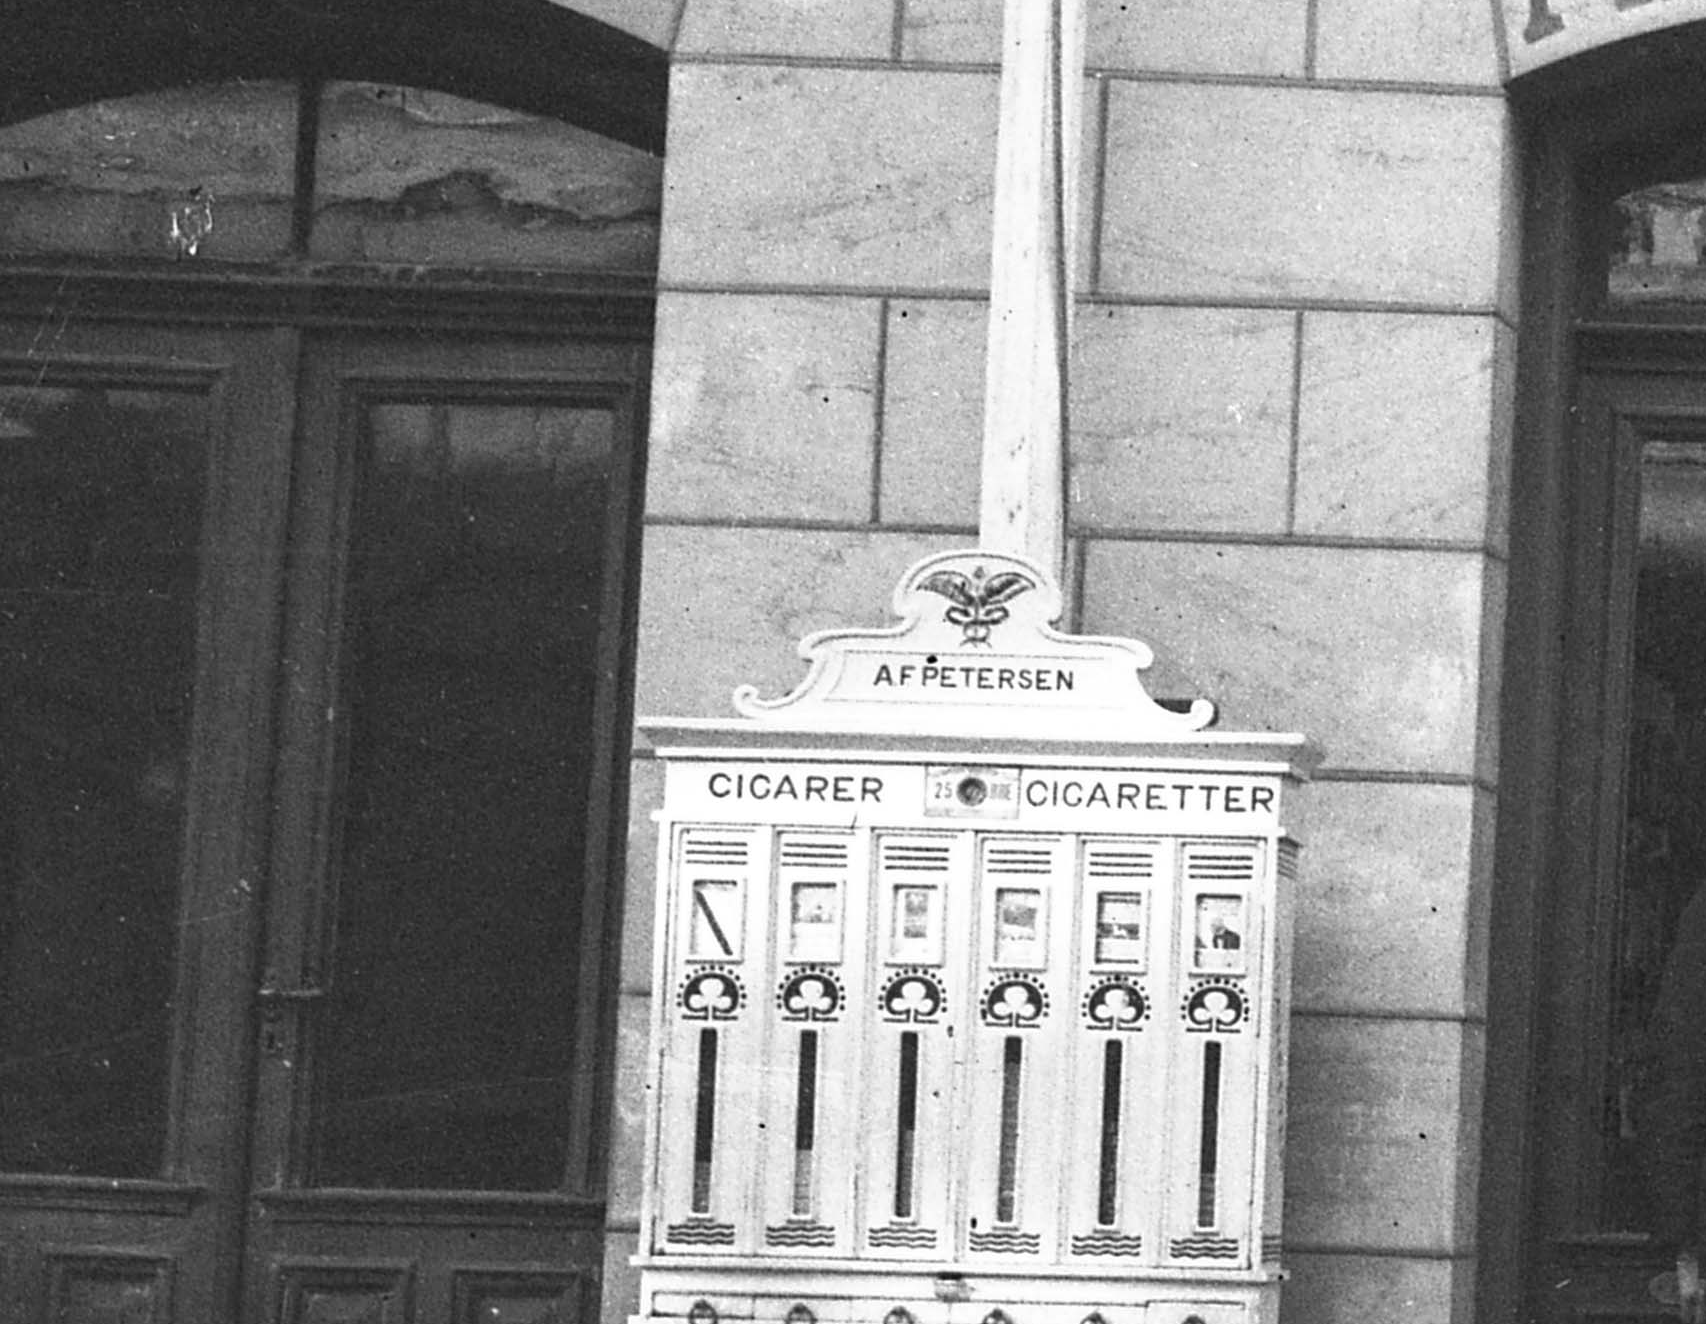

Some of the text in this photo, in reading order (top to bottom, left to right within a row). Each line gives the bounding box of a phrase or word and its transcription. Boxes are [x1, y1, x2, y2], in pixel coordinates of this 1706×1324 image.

[921, 665, 1074, 691] PETERSEN
[708, 771, 1276, 812] CIGARER CIGARETTER
